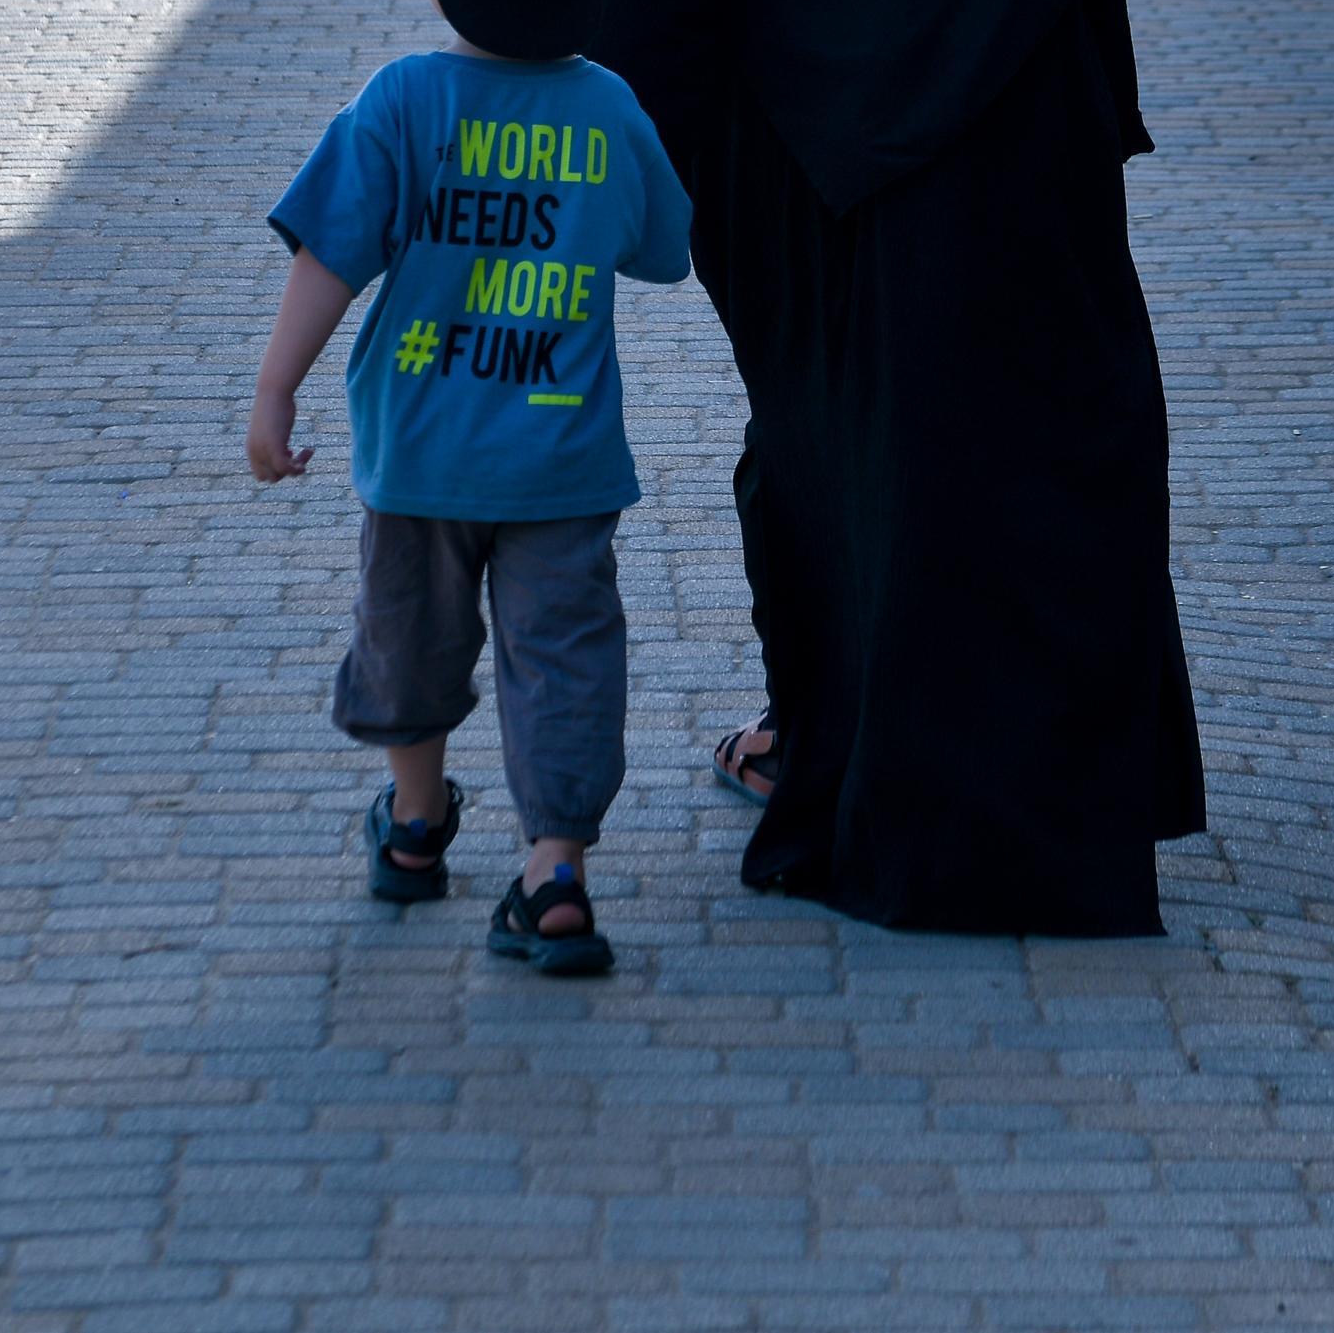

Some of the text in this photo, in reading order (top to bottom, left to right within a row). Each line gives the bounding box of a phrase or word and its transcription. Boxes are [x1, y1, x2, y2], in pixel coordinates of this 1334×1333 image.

[460, 118, 608, 185] WORLD
[415, 187, 560, 252] NEEDS
[465, 258, 596, 321] MORE
